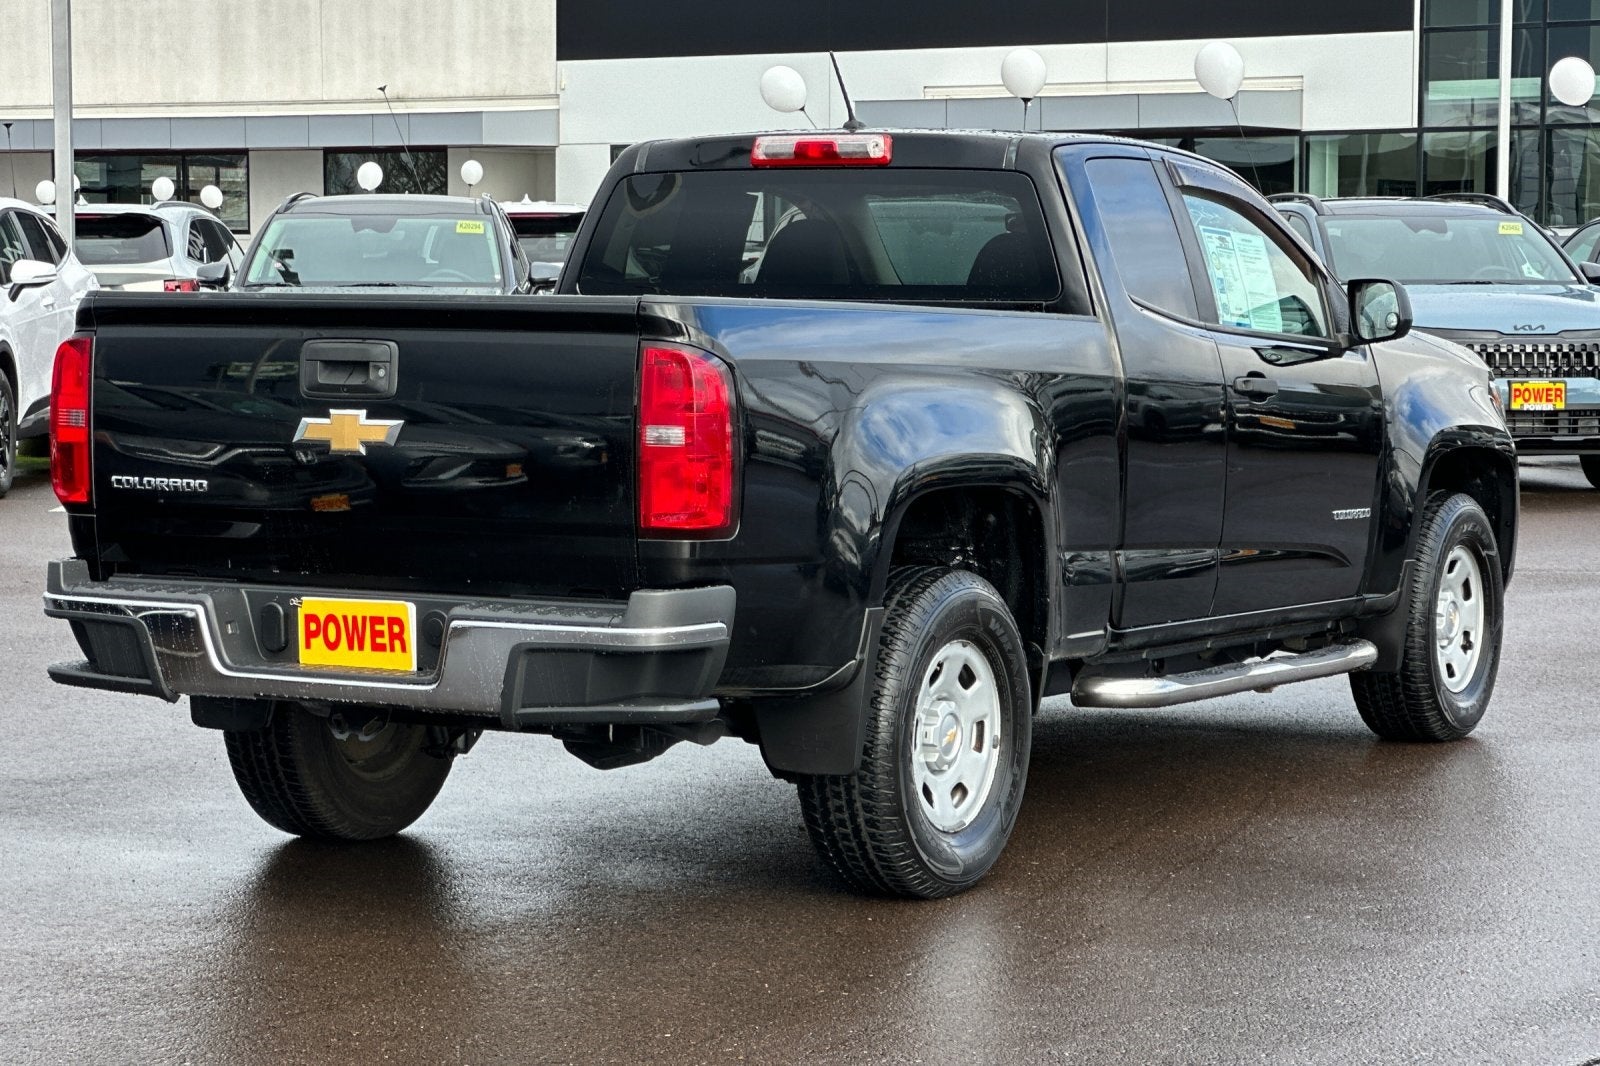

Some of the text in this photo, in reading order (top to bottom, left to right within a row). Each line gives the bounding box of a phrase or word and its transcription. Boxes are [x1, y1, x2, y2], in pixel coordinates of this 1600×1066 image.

[1513, 387, 1563, 403] POWER
[1523, 403, 1553, 411] POWER
[111, 475, 208, 492] COLORADO
[304, 613, 407, 653] POWER
